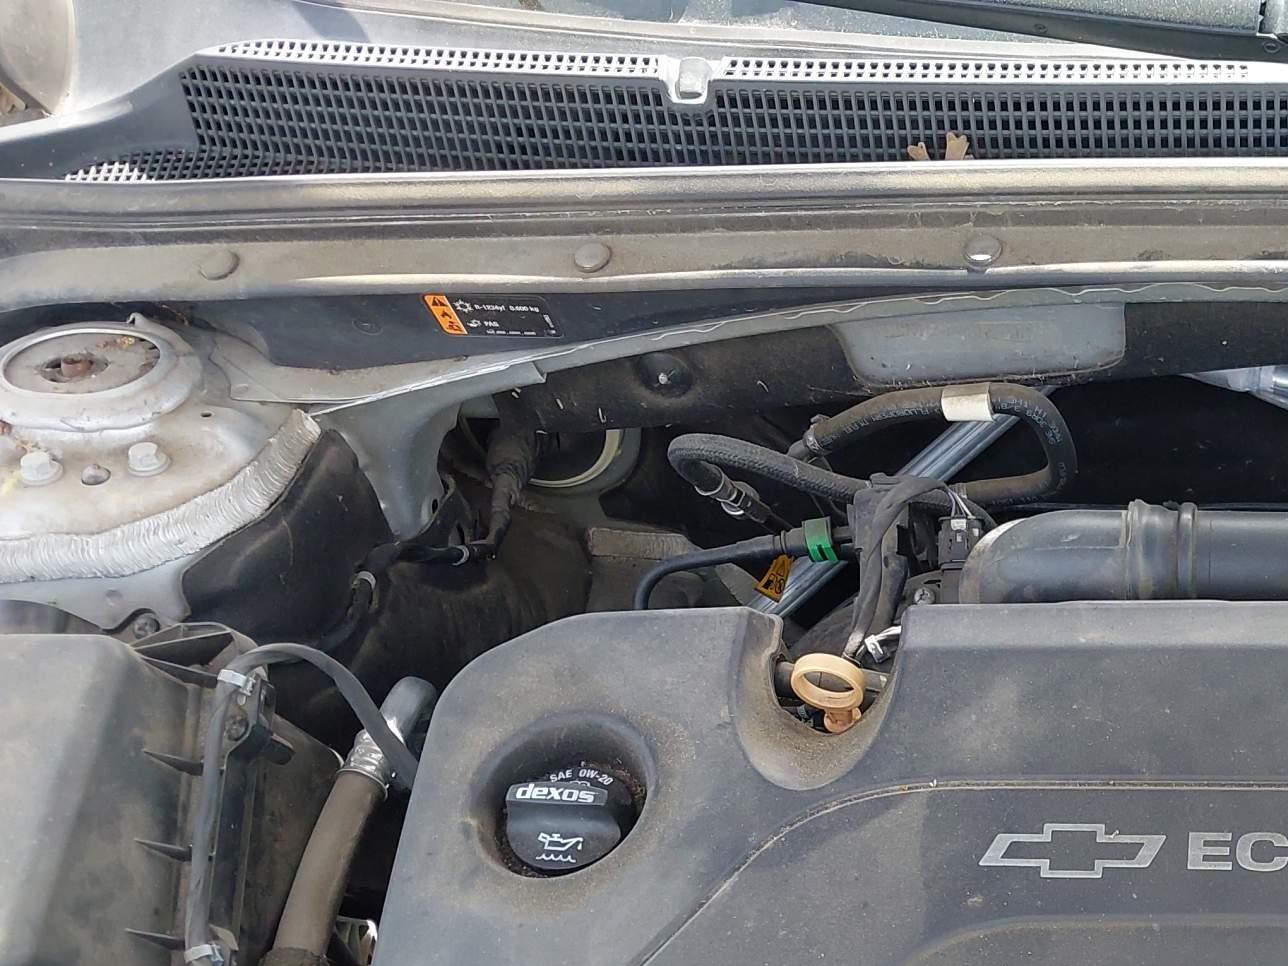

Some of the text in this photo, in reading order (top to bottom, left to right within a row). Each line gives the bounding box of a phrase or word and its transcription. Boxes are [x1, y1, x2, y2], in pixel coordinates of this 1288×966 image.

[549, 768, 614, 786] SAE 0W-20
[515, 783, 599, 803] dexos
